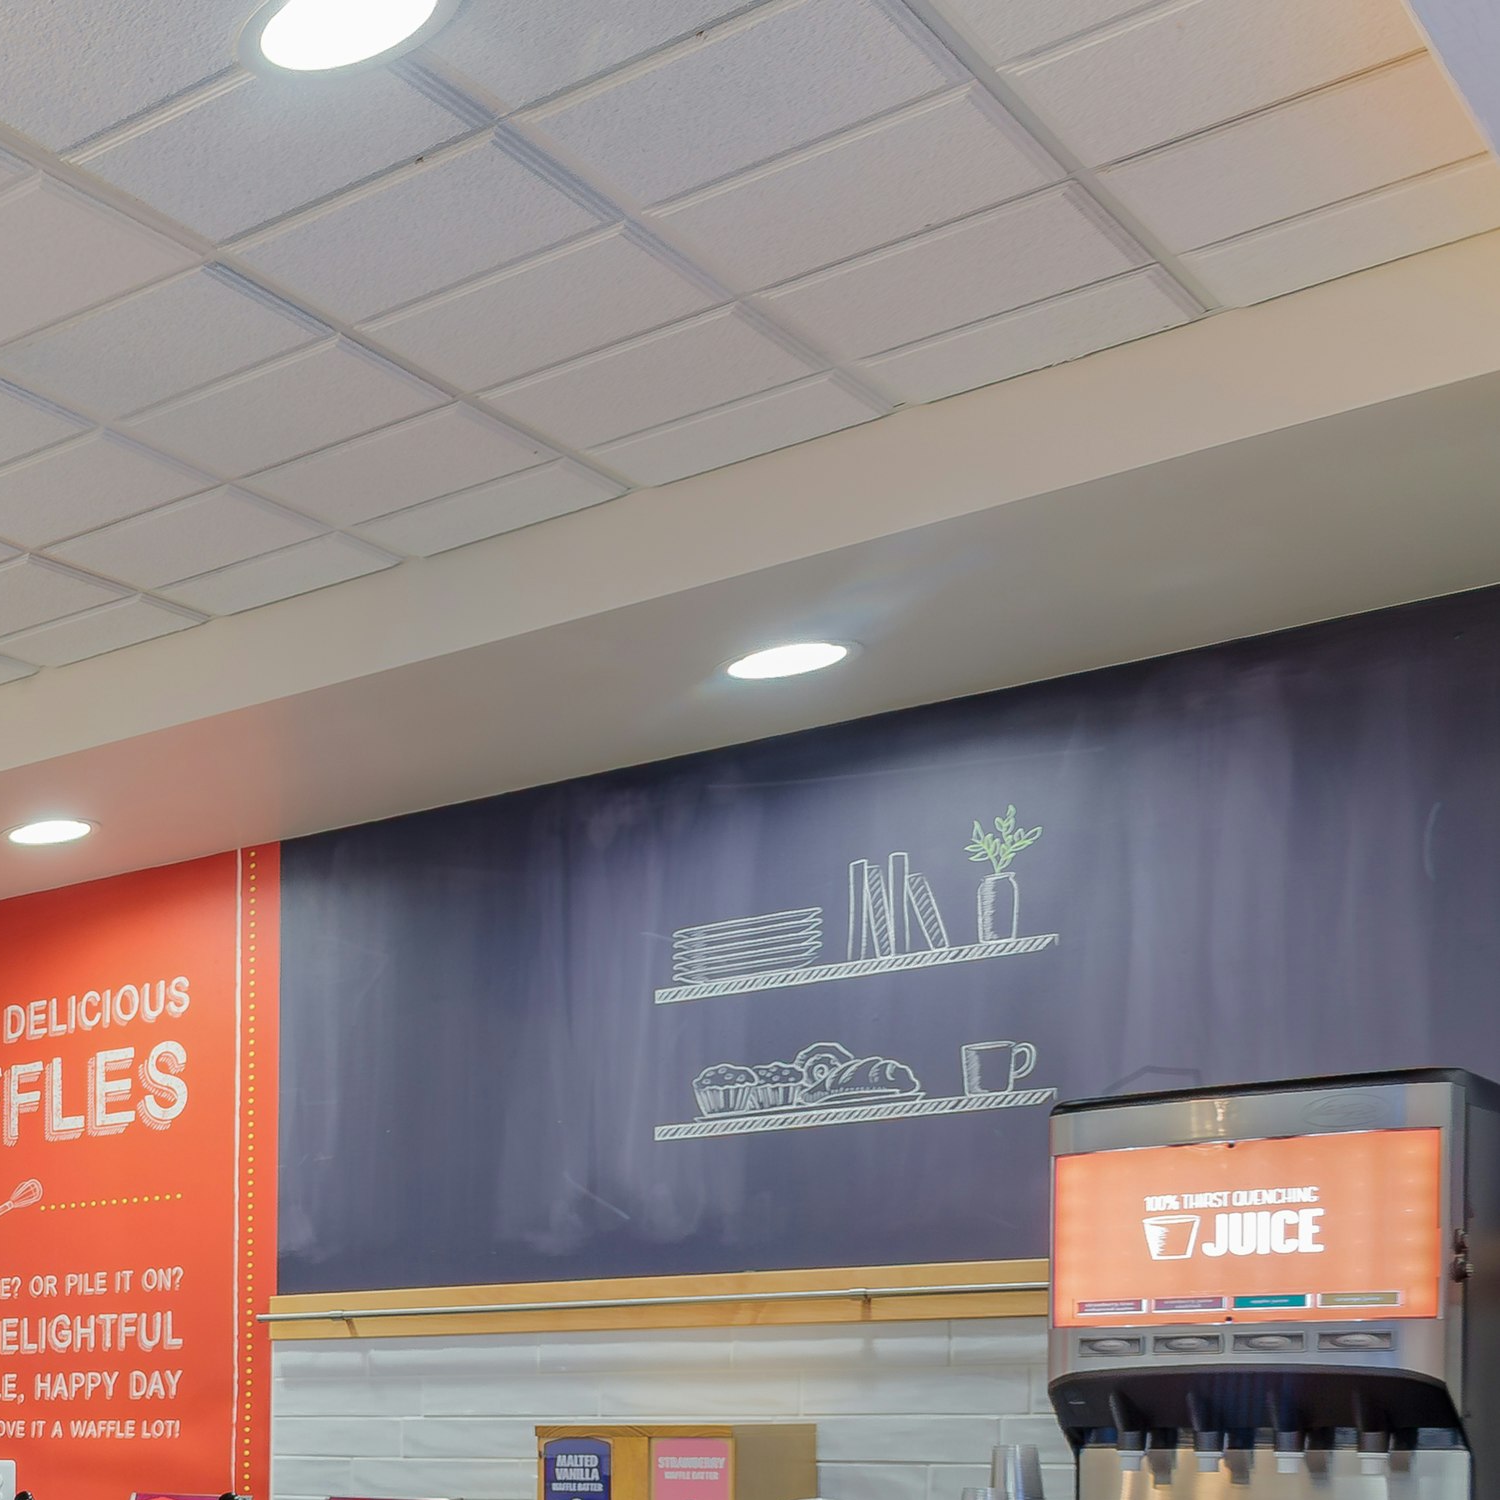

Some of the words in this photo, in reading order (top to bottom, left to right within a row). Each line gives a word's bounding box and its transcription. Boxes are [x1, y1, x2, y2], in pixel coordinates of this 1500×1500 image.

[3, 976, 190, 1044] DELICIOUS
[1143, 1194, 1180, 1212] 100%
[1181, 1190, 1231, 1210] THIRST
[1232, 1186, 1320, 1206] QUENCHING
[1201, 1207, 1325, 1257] JUICE
[29, 1275, 58, 1298] OR
[65, 1272, 108, 1296] PILE
[115, 1270, 134, 1294] IT
[142, 1266, 184, 1292] ON?
[34, 1371, 119, 1401] HAPPY
[129, 1370, 183, 1399] DAY
[31, 1420, 46, 1438] IT
[51, 1420, 63, 1438] A
[70, 1420, 136, 1438] WAFFLE
[141, 1420, 181, 1438] LOT!
[556, 1454, 599, 1467] MALTED
[658, 1456, 726, 1469] STRAWBERRY
[554, 1468, 600, 1481] VANILLA
